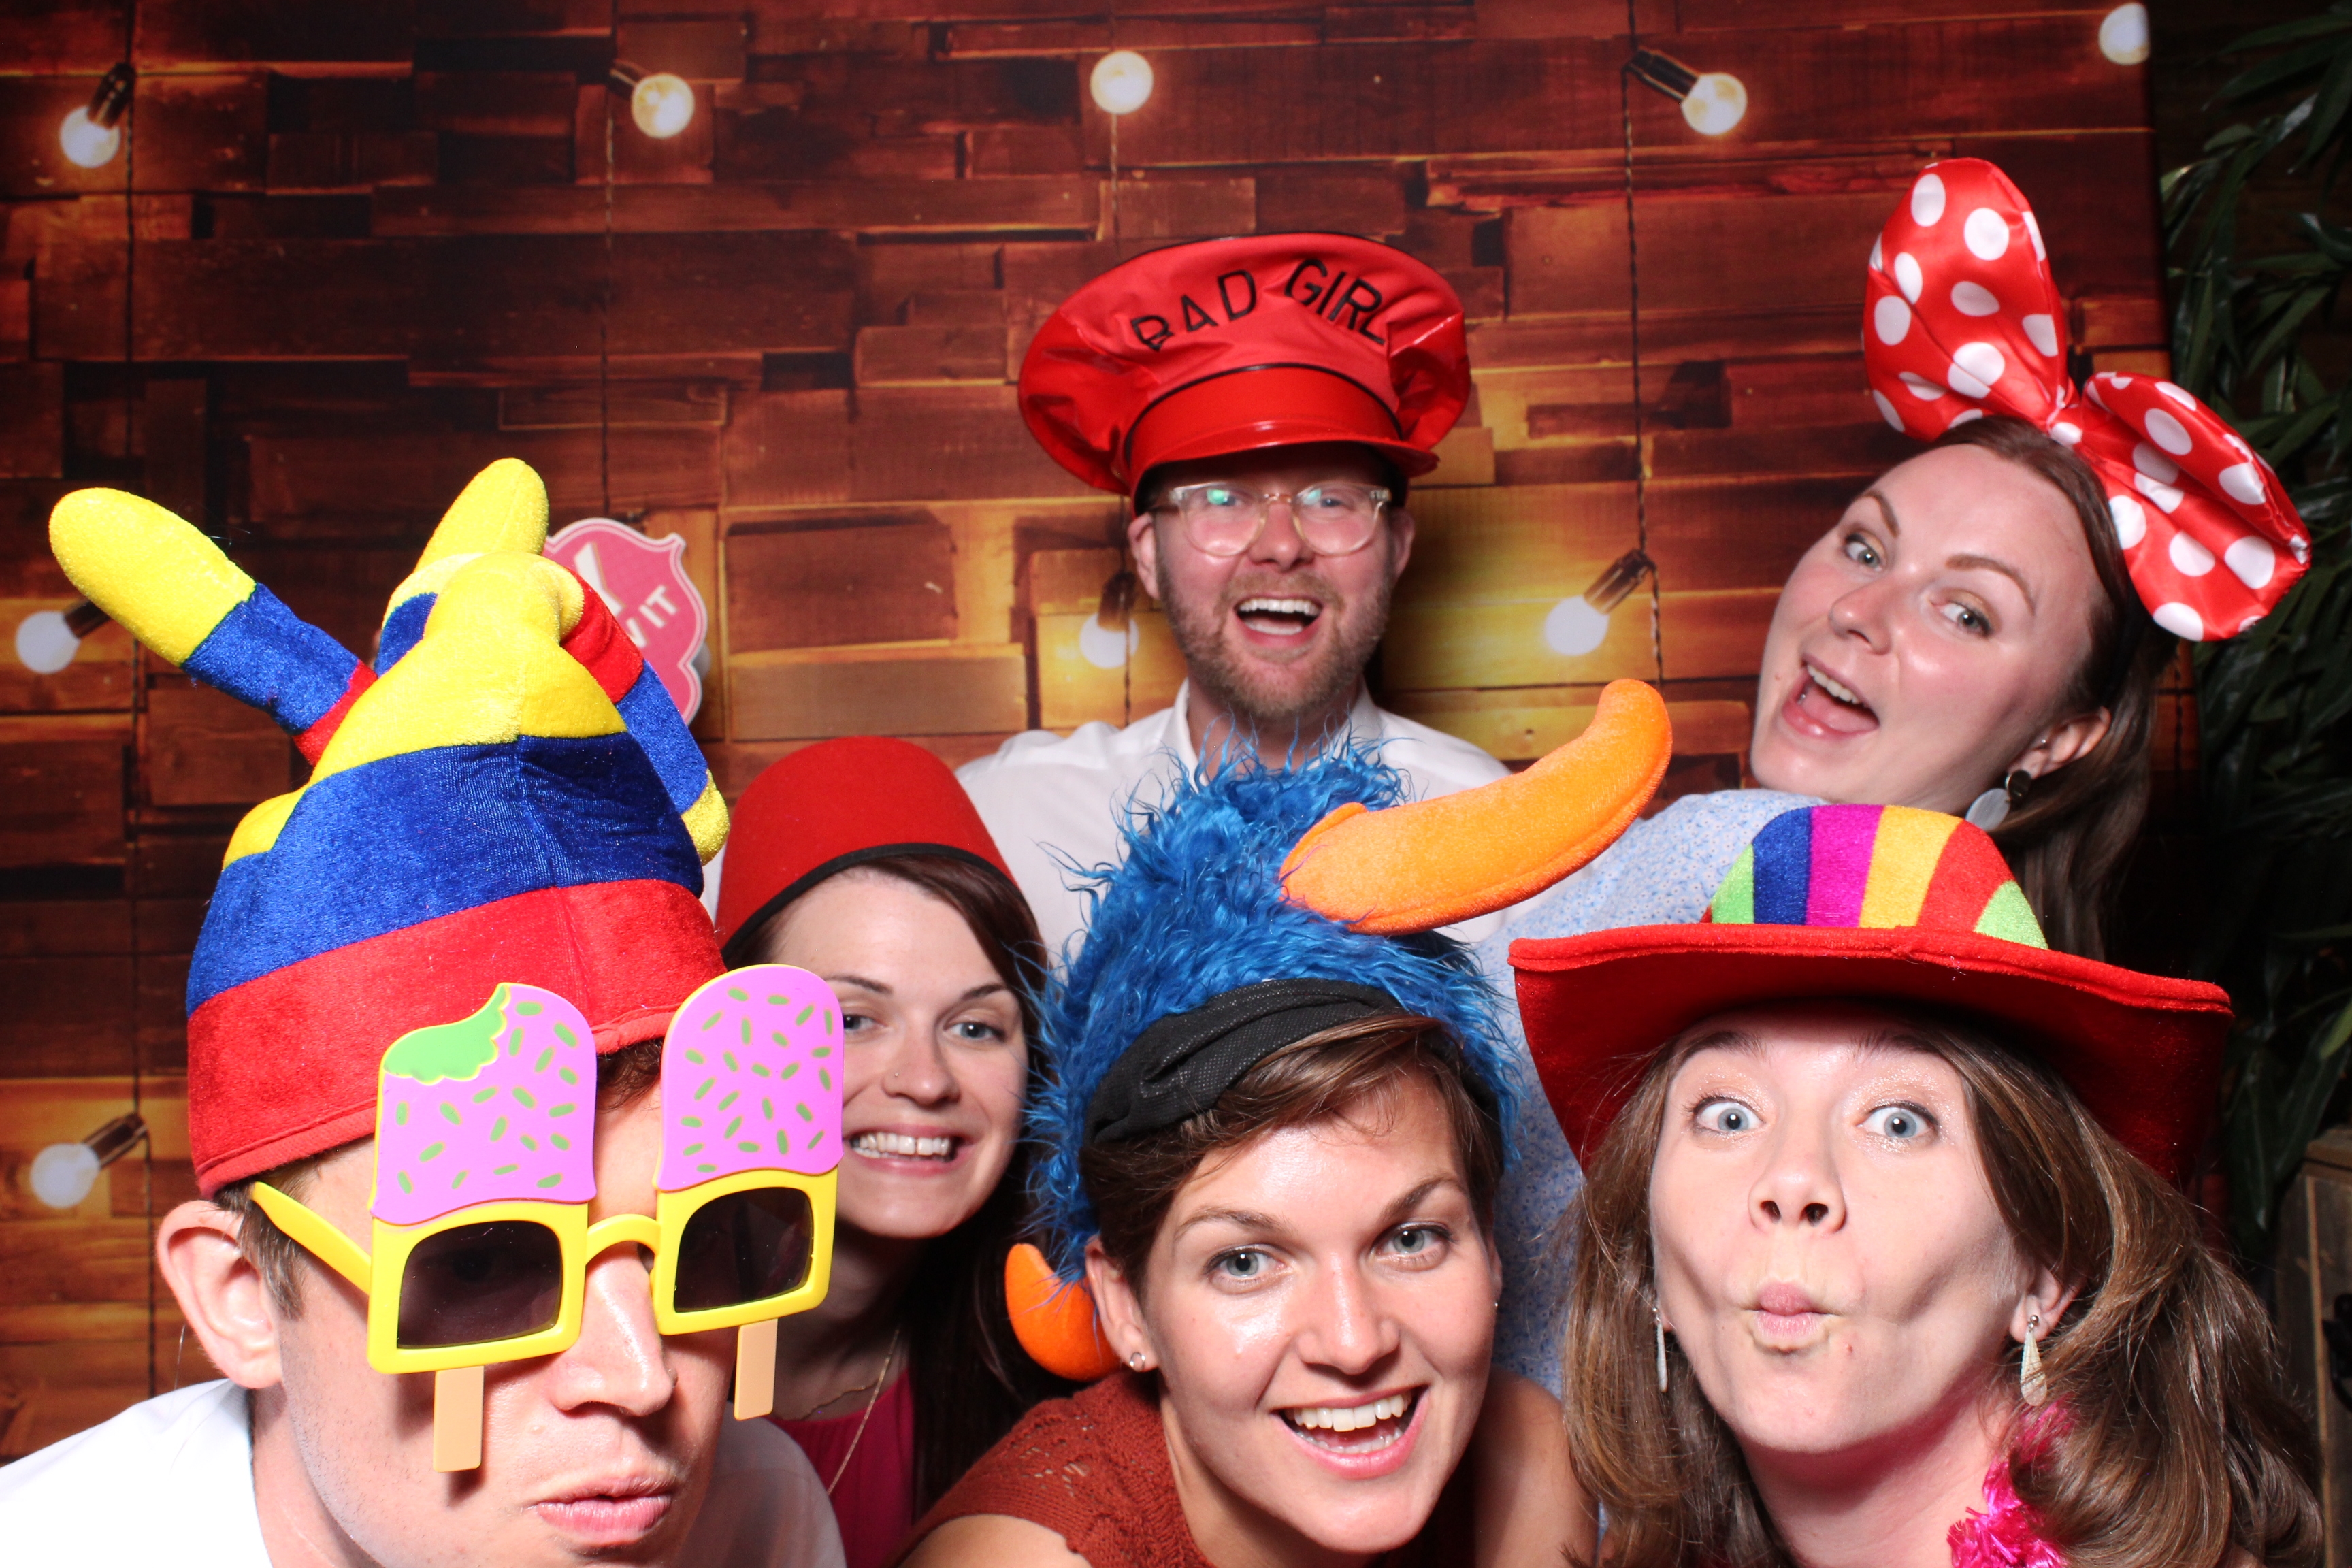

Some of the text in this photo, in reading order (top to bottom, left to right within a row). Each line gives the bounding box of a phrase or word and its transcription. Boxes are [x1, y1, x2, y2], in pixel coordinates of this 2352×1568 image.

[1130, 258, 1387, 352] BAD GIRL
[638, 585, 677, 629] IT
